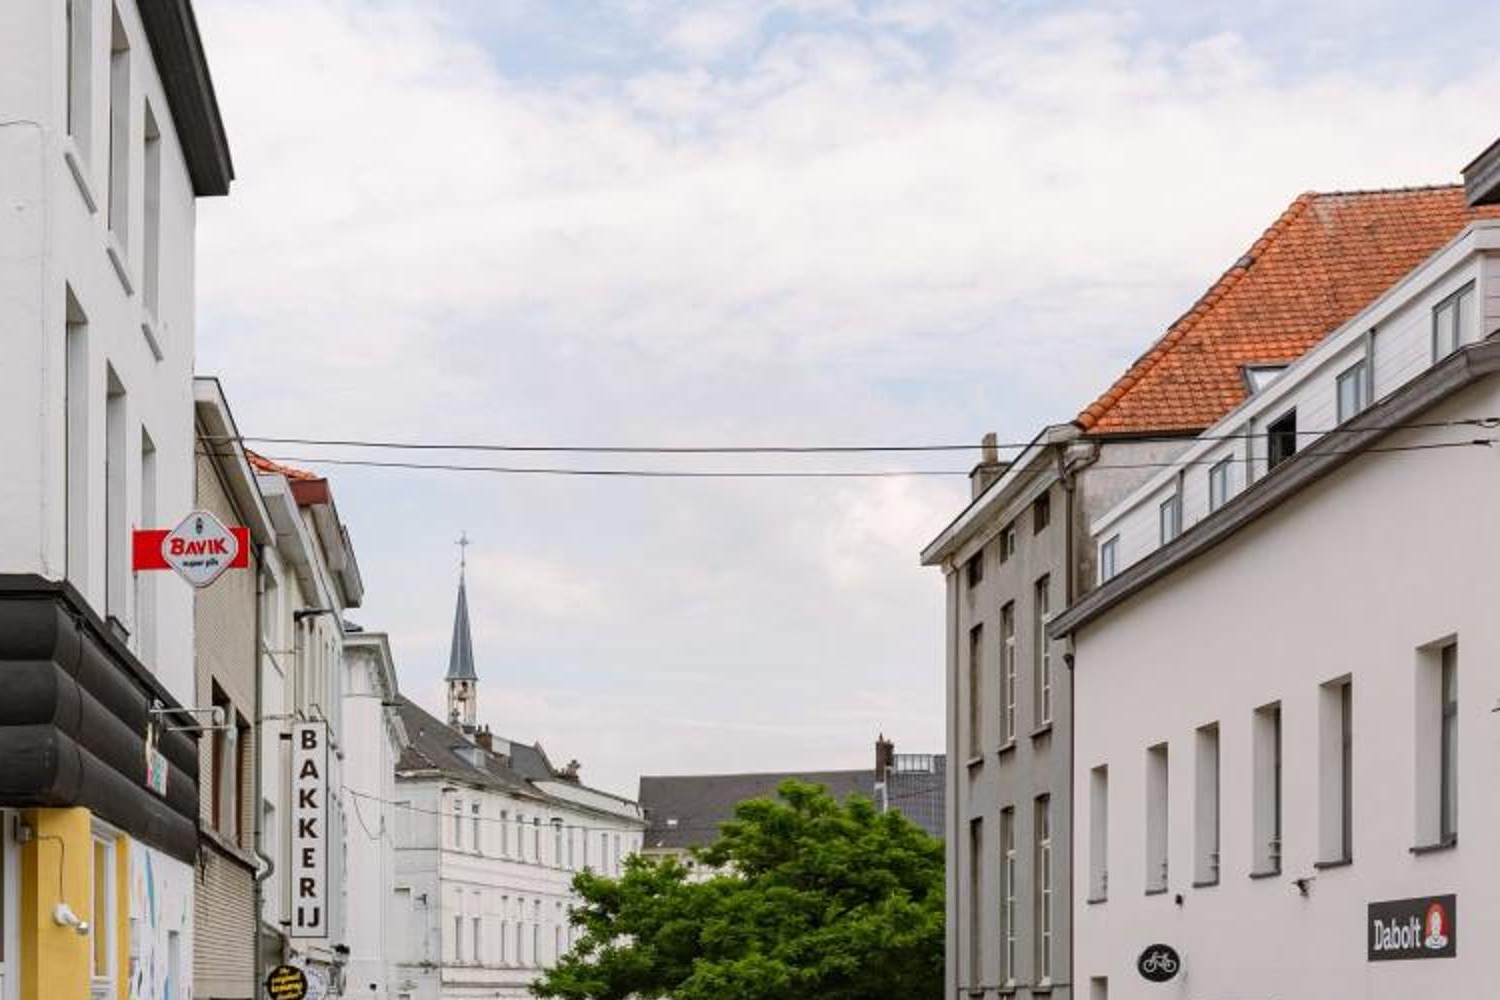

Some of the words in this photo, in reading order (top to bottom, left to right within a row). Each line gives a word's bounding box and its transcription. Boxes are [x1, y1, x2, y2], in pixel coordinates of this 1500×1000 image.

[171, 537, 229, 555] BAVIK
[297, 729, 320, 928] BAKKERIJ
[1373, 915, 1422, 951] Dabolt
